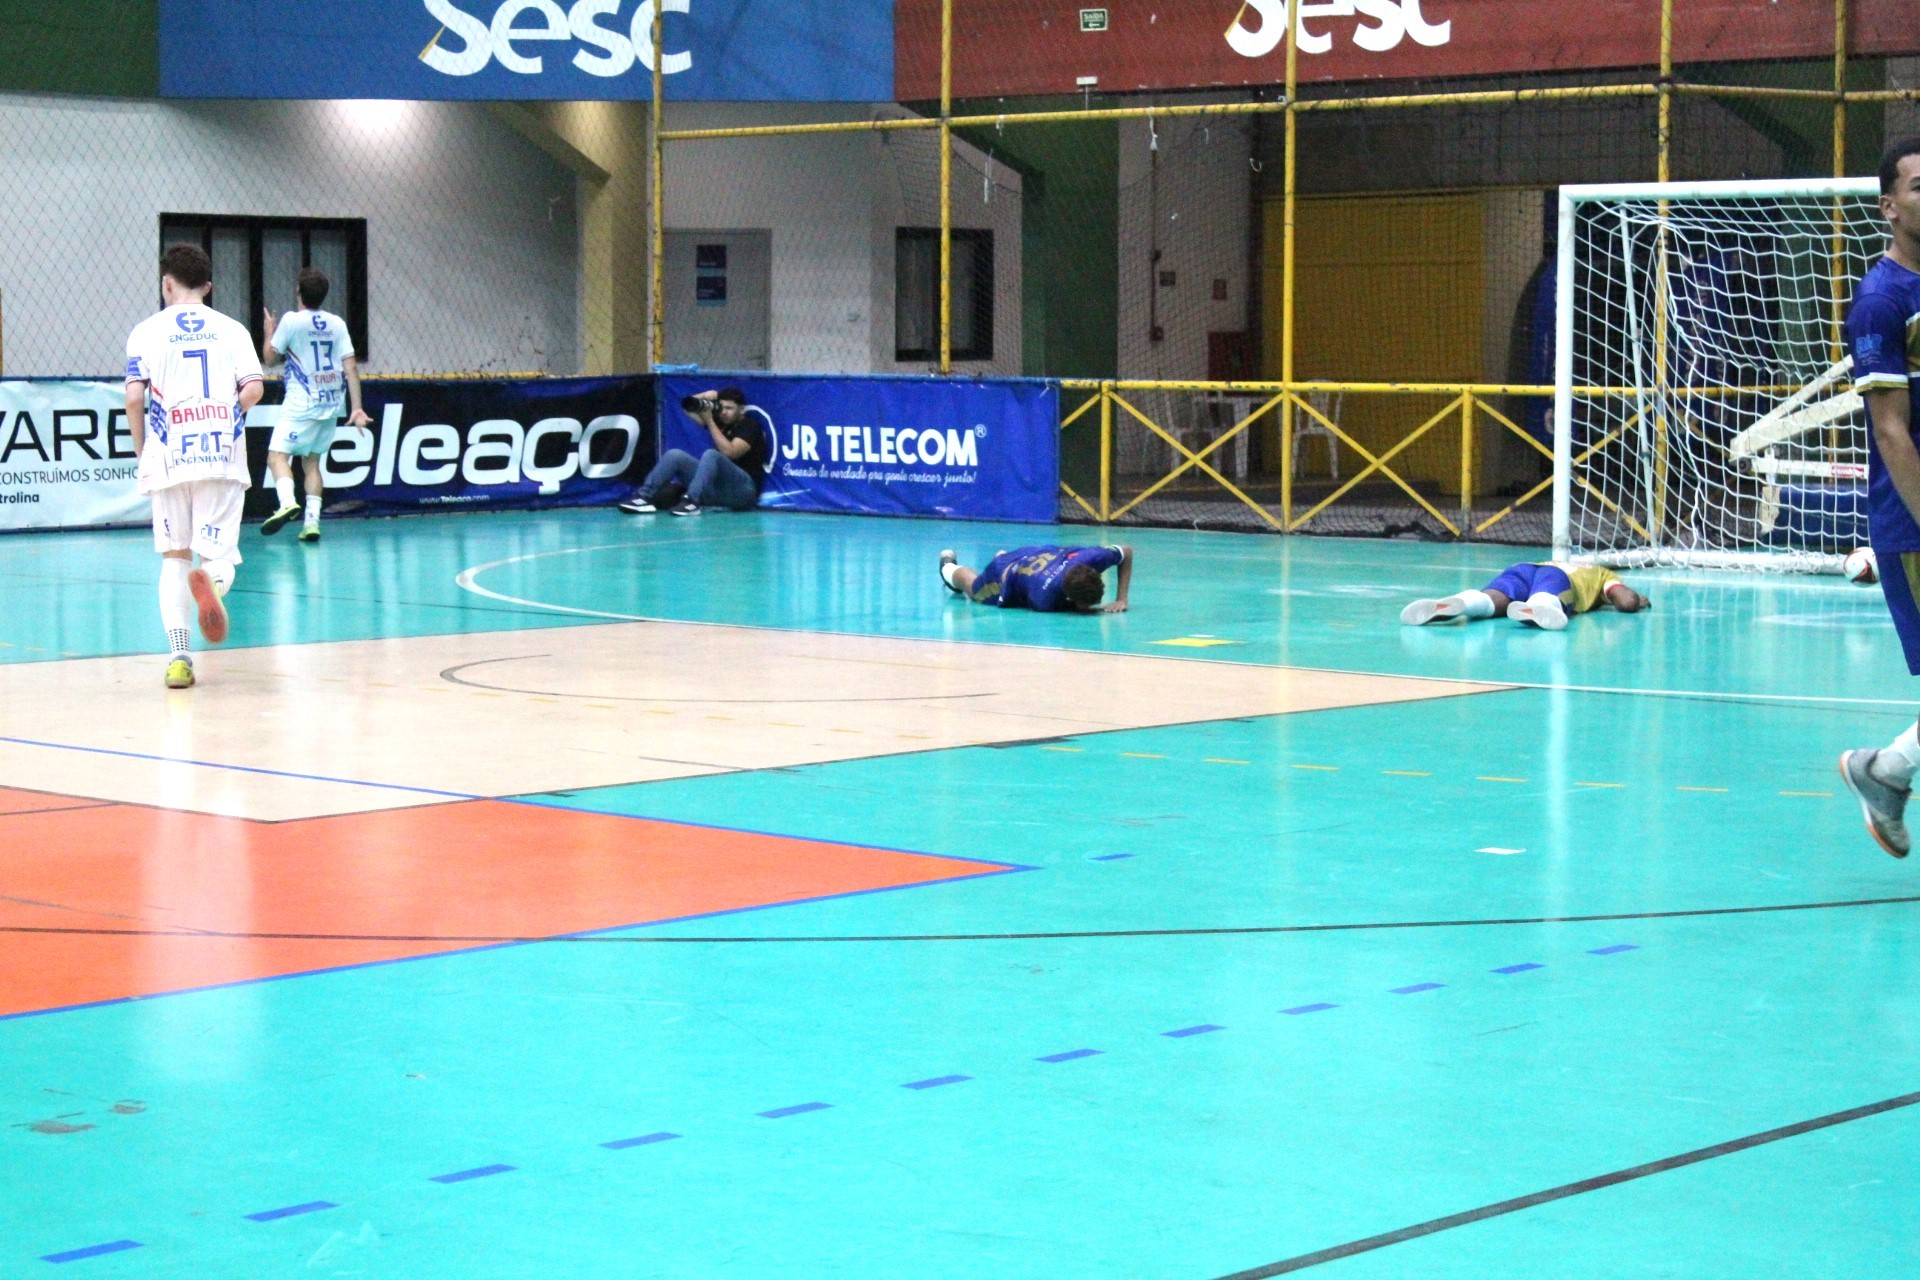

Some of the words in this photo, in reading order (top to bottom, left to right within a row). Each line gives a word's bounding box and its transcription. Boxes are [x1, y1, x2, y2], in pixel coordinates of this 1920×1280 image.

[418, 0, 692, 77] Sesc
[1224, 0, 1451, 57] Sesc
[169, 332, 218, 343] ENGEDUC
[310, 340, 334, 371] 13
[182, 348, 211, 399] 7
[171, 404, 229, 425] BRUNO
[0, 408, 149, 464] ARE
[782, 424, 820, 461] JR
[0, 467, 90, 485] ONSTRUÍMOS
[830, 464, 867, 479] verdade
